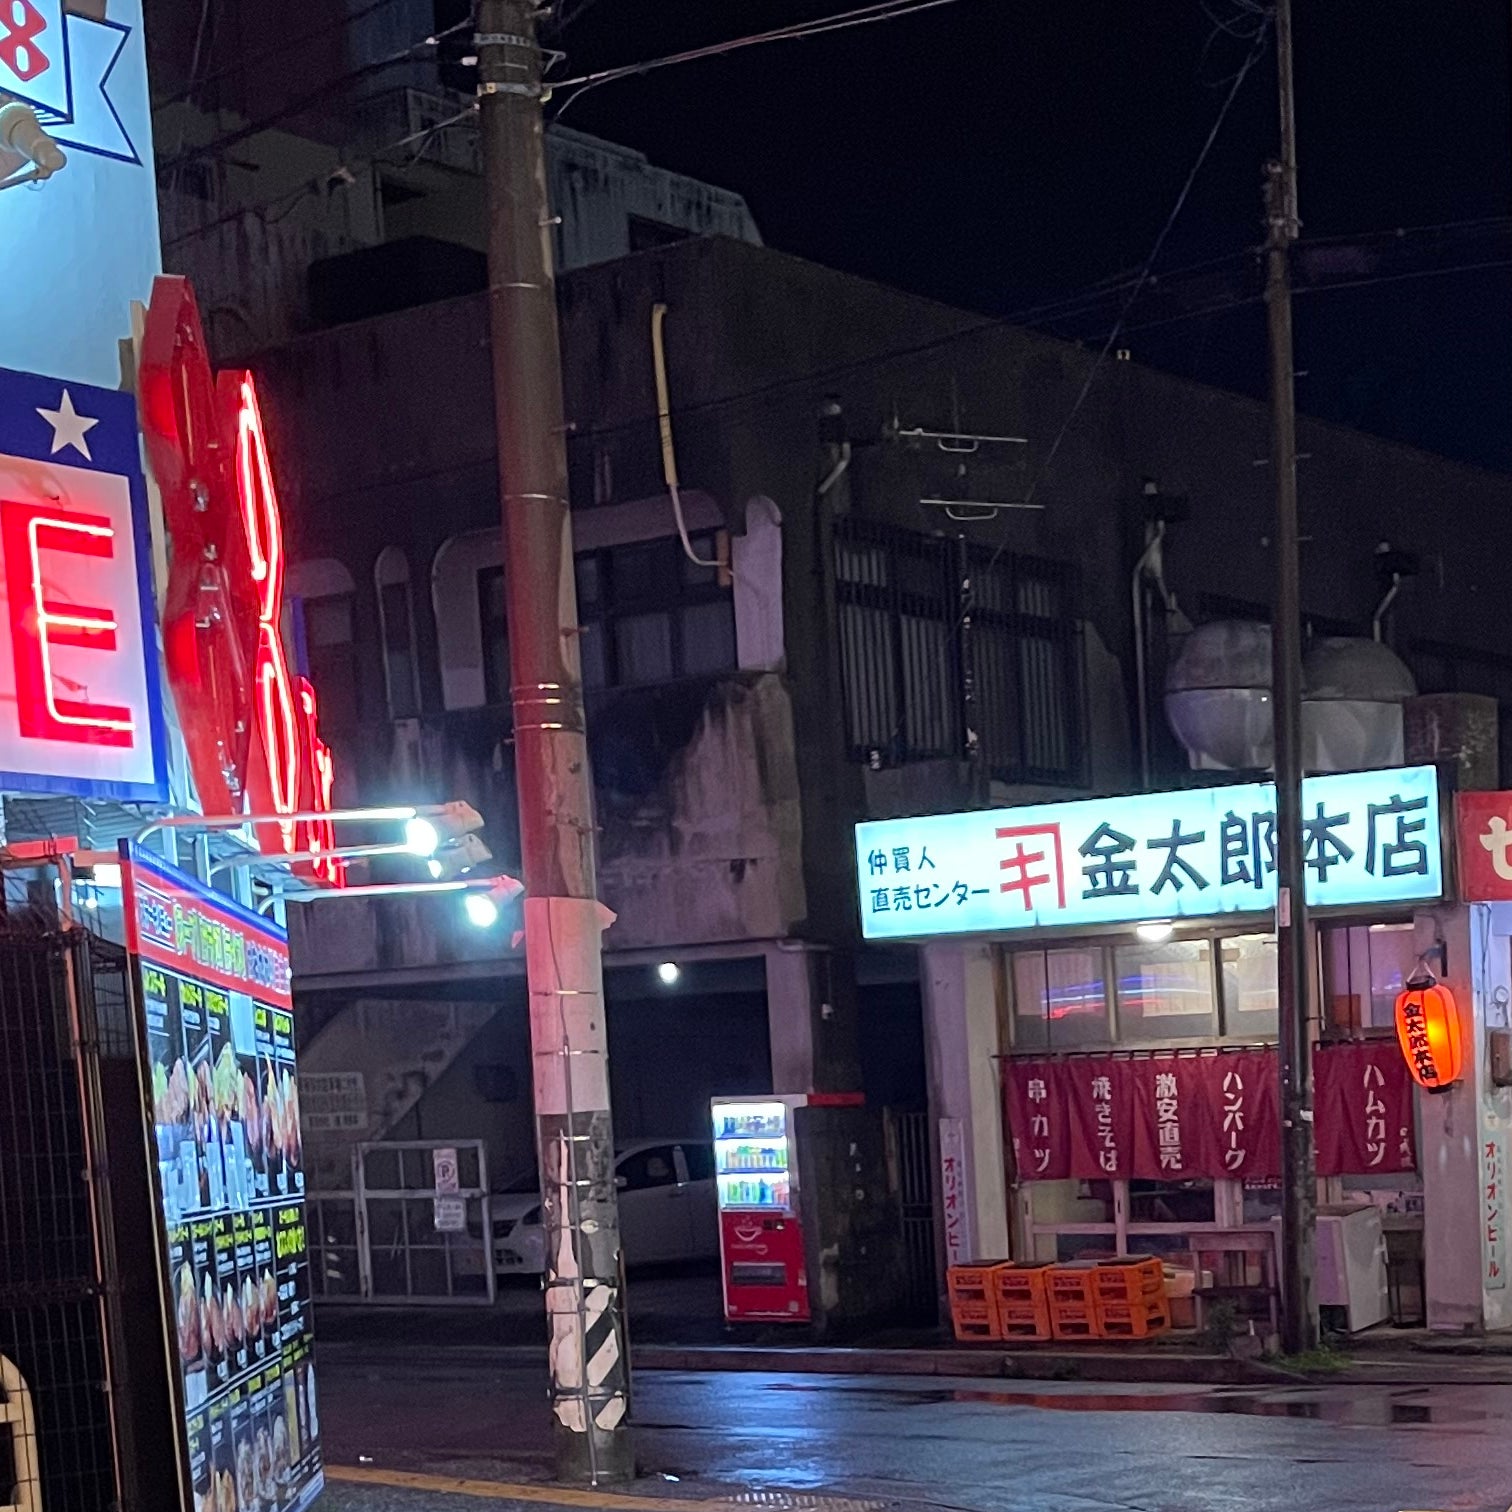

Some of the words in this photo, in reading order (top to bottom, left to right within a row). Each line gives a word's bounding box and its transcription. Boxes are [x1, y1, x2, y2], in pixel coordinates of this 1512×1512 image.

[0, 500, 134, 749] E
[867, 846, 936, 876] 仲買人
[1078, 793, 1431, 901] 金太郎本店
[870, 880, 990, 913] 直売センター
[1403, 1002, 1438, 1080] 金太郎本店
[1027, 1078, 1051, 1173] 串カツ
[1155, 1073, 1183, 1170] 激安直売
[1222, 1071, 1247, 1171] ハンバーグ
[1362, 1064, 1386, 1167] ハムカツ
